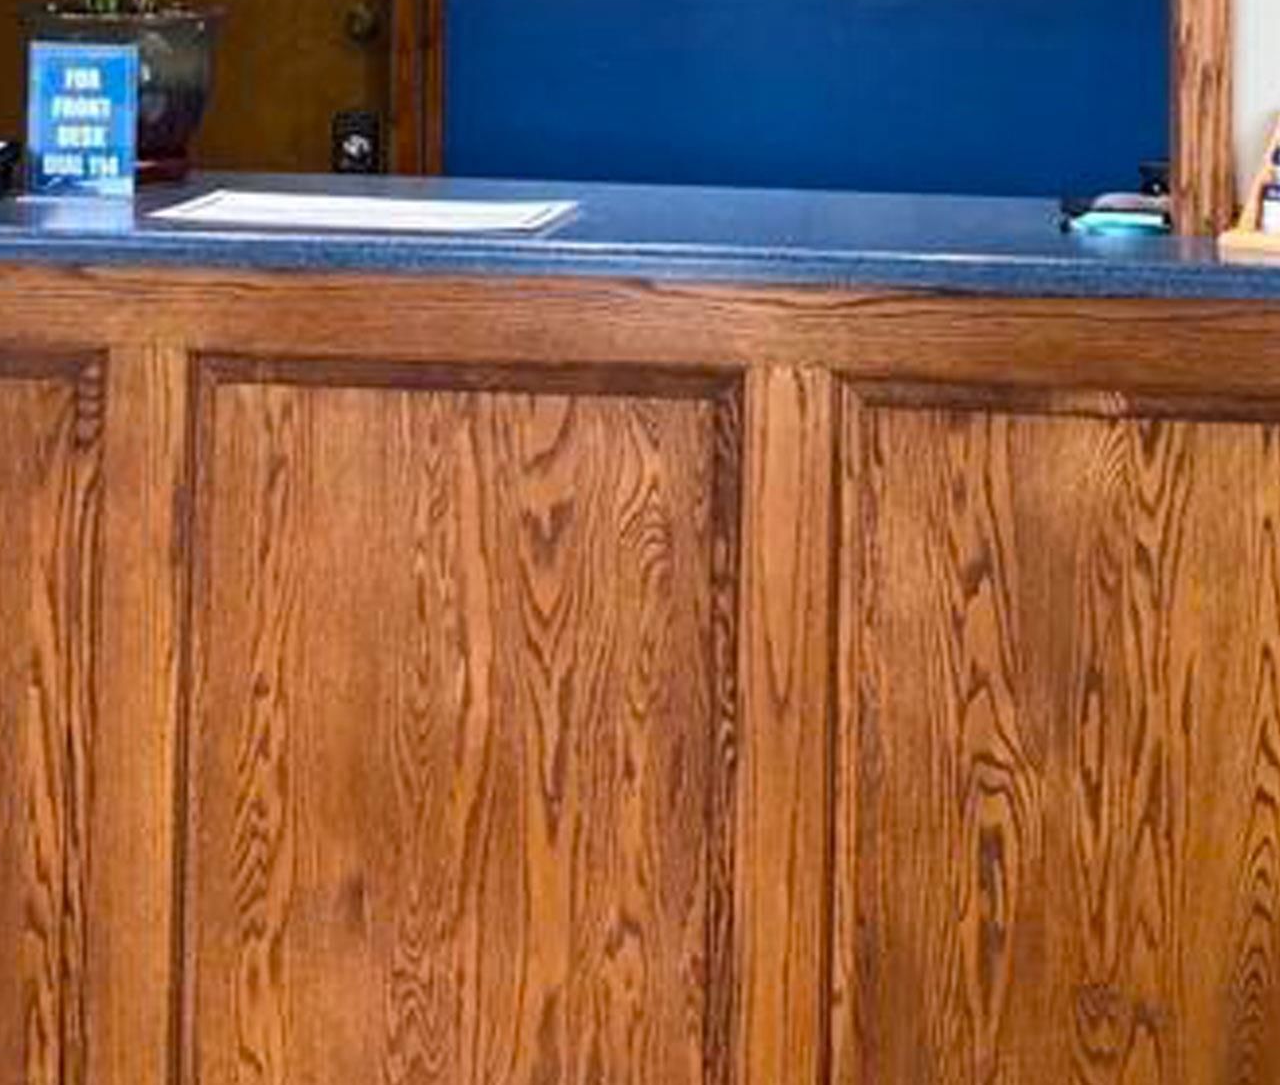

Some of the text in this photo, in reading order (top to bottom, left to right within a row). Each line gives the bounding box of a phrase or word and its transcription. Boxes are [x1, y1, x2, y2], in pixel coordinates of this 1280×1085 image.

[65, 67, 101, 89] FOR
[51, 97, 112, 119] FRONT
[57, 125, 107, 149] DESK
